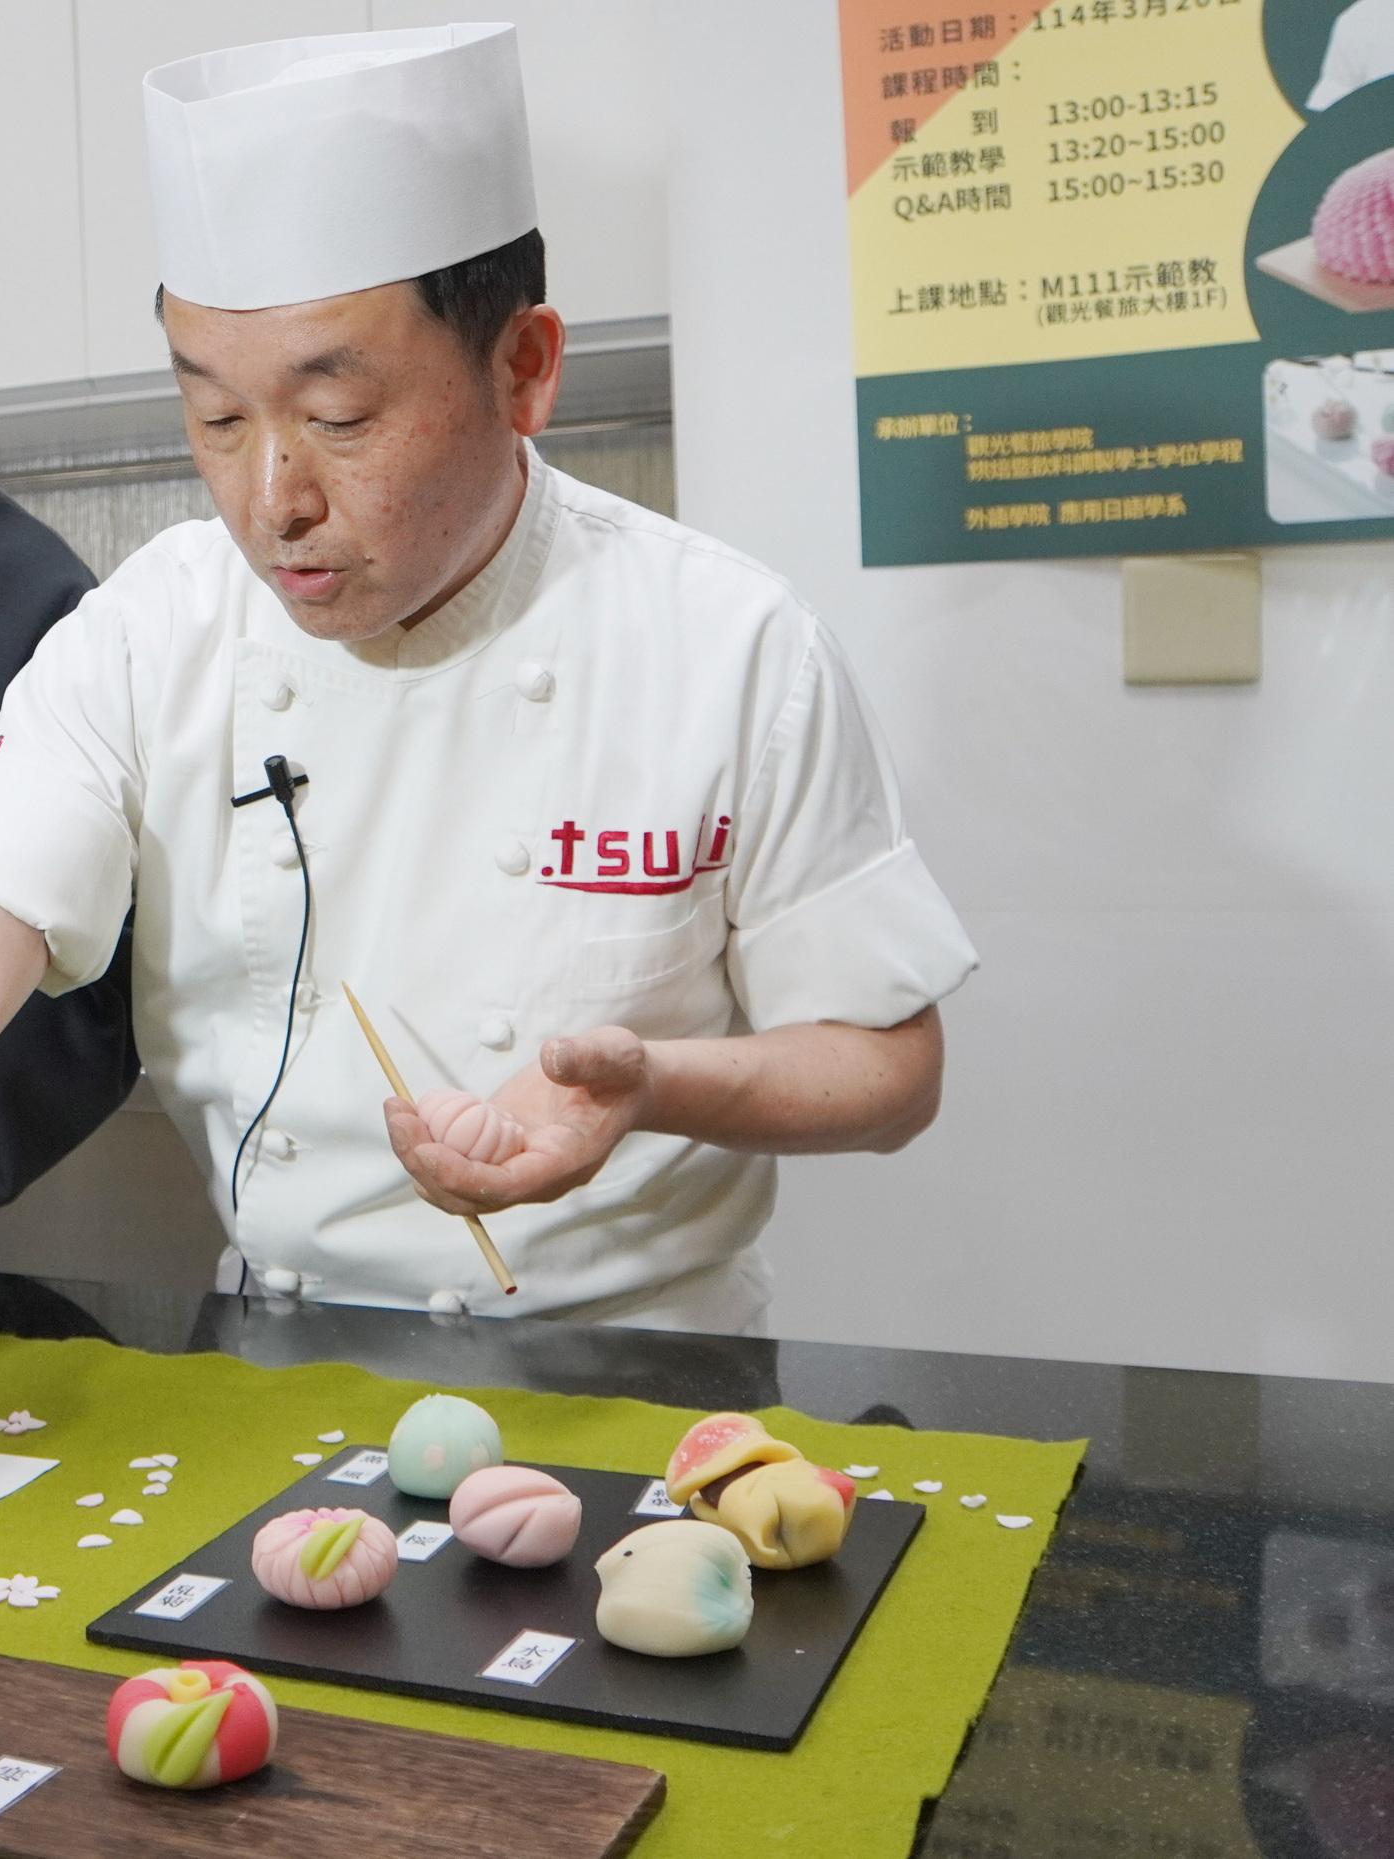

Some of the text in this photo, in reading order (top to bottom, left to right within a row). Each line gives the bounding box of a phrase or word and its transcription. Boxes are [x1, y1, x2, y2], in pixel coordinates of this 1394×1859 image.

[972, 109, 999, 135] 到
[1047, 82, 1219, 126] 13:00-13:15
[892, 120, 1226, 183] 示範教學 13:20~15:00
[893, 160, 1225, 222] Q&A時間 15:00~15:30
